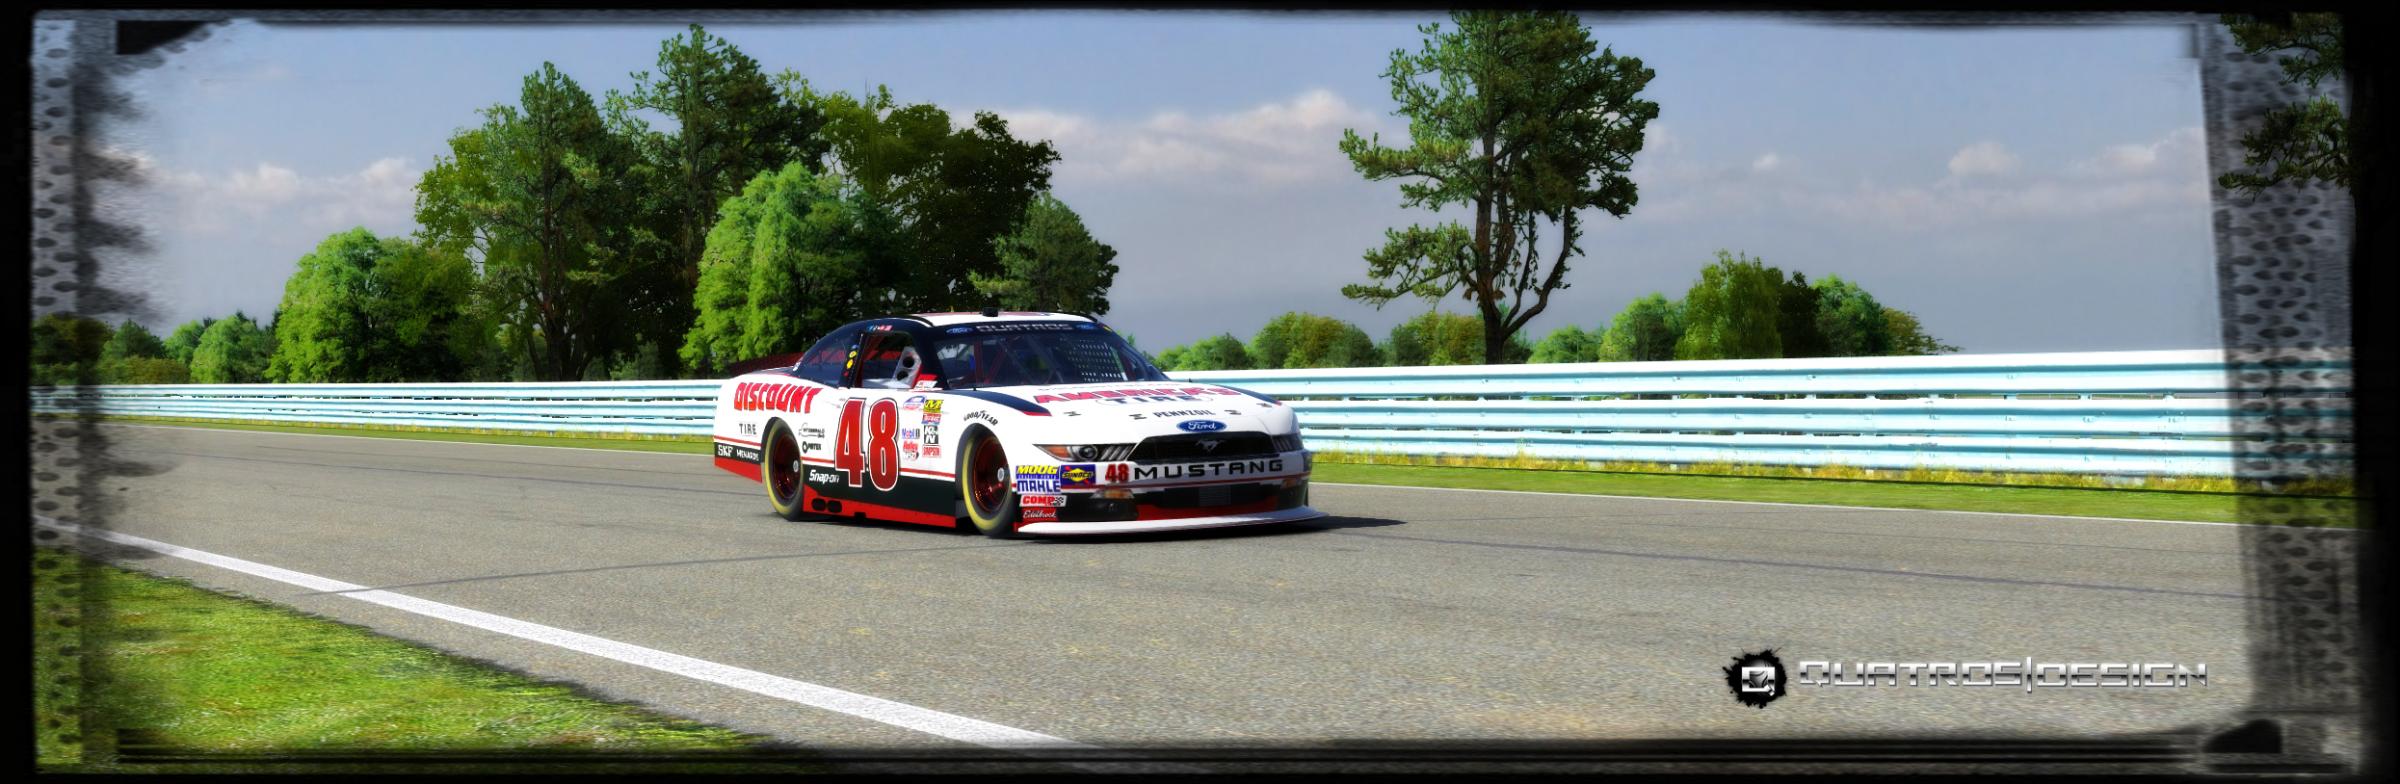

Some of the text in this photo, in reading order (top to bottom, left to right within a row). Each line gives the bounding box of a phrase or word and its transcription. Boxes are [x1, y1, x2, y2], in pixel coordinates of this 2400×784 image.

[734, 382, 823, 414] DISCOUNT
[1153, 409, 1215, 418] PENNZOIL
[739, 423, 757, 435] TIRE
[1187, 420, 1217, 432] Ford
[834, 397, 899, 491] 48
[717, 444, 733, 457] SKF
[1018, 465, 1058, 474] MOOG
[1105, 459, 1283, 482] 48 MUSTANG
[809, 469, 840, 484] Snap-on
[1017, 480, 1060, 492] MAHLE
[1022, 496, 1055, 504] COMP
